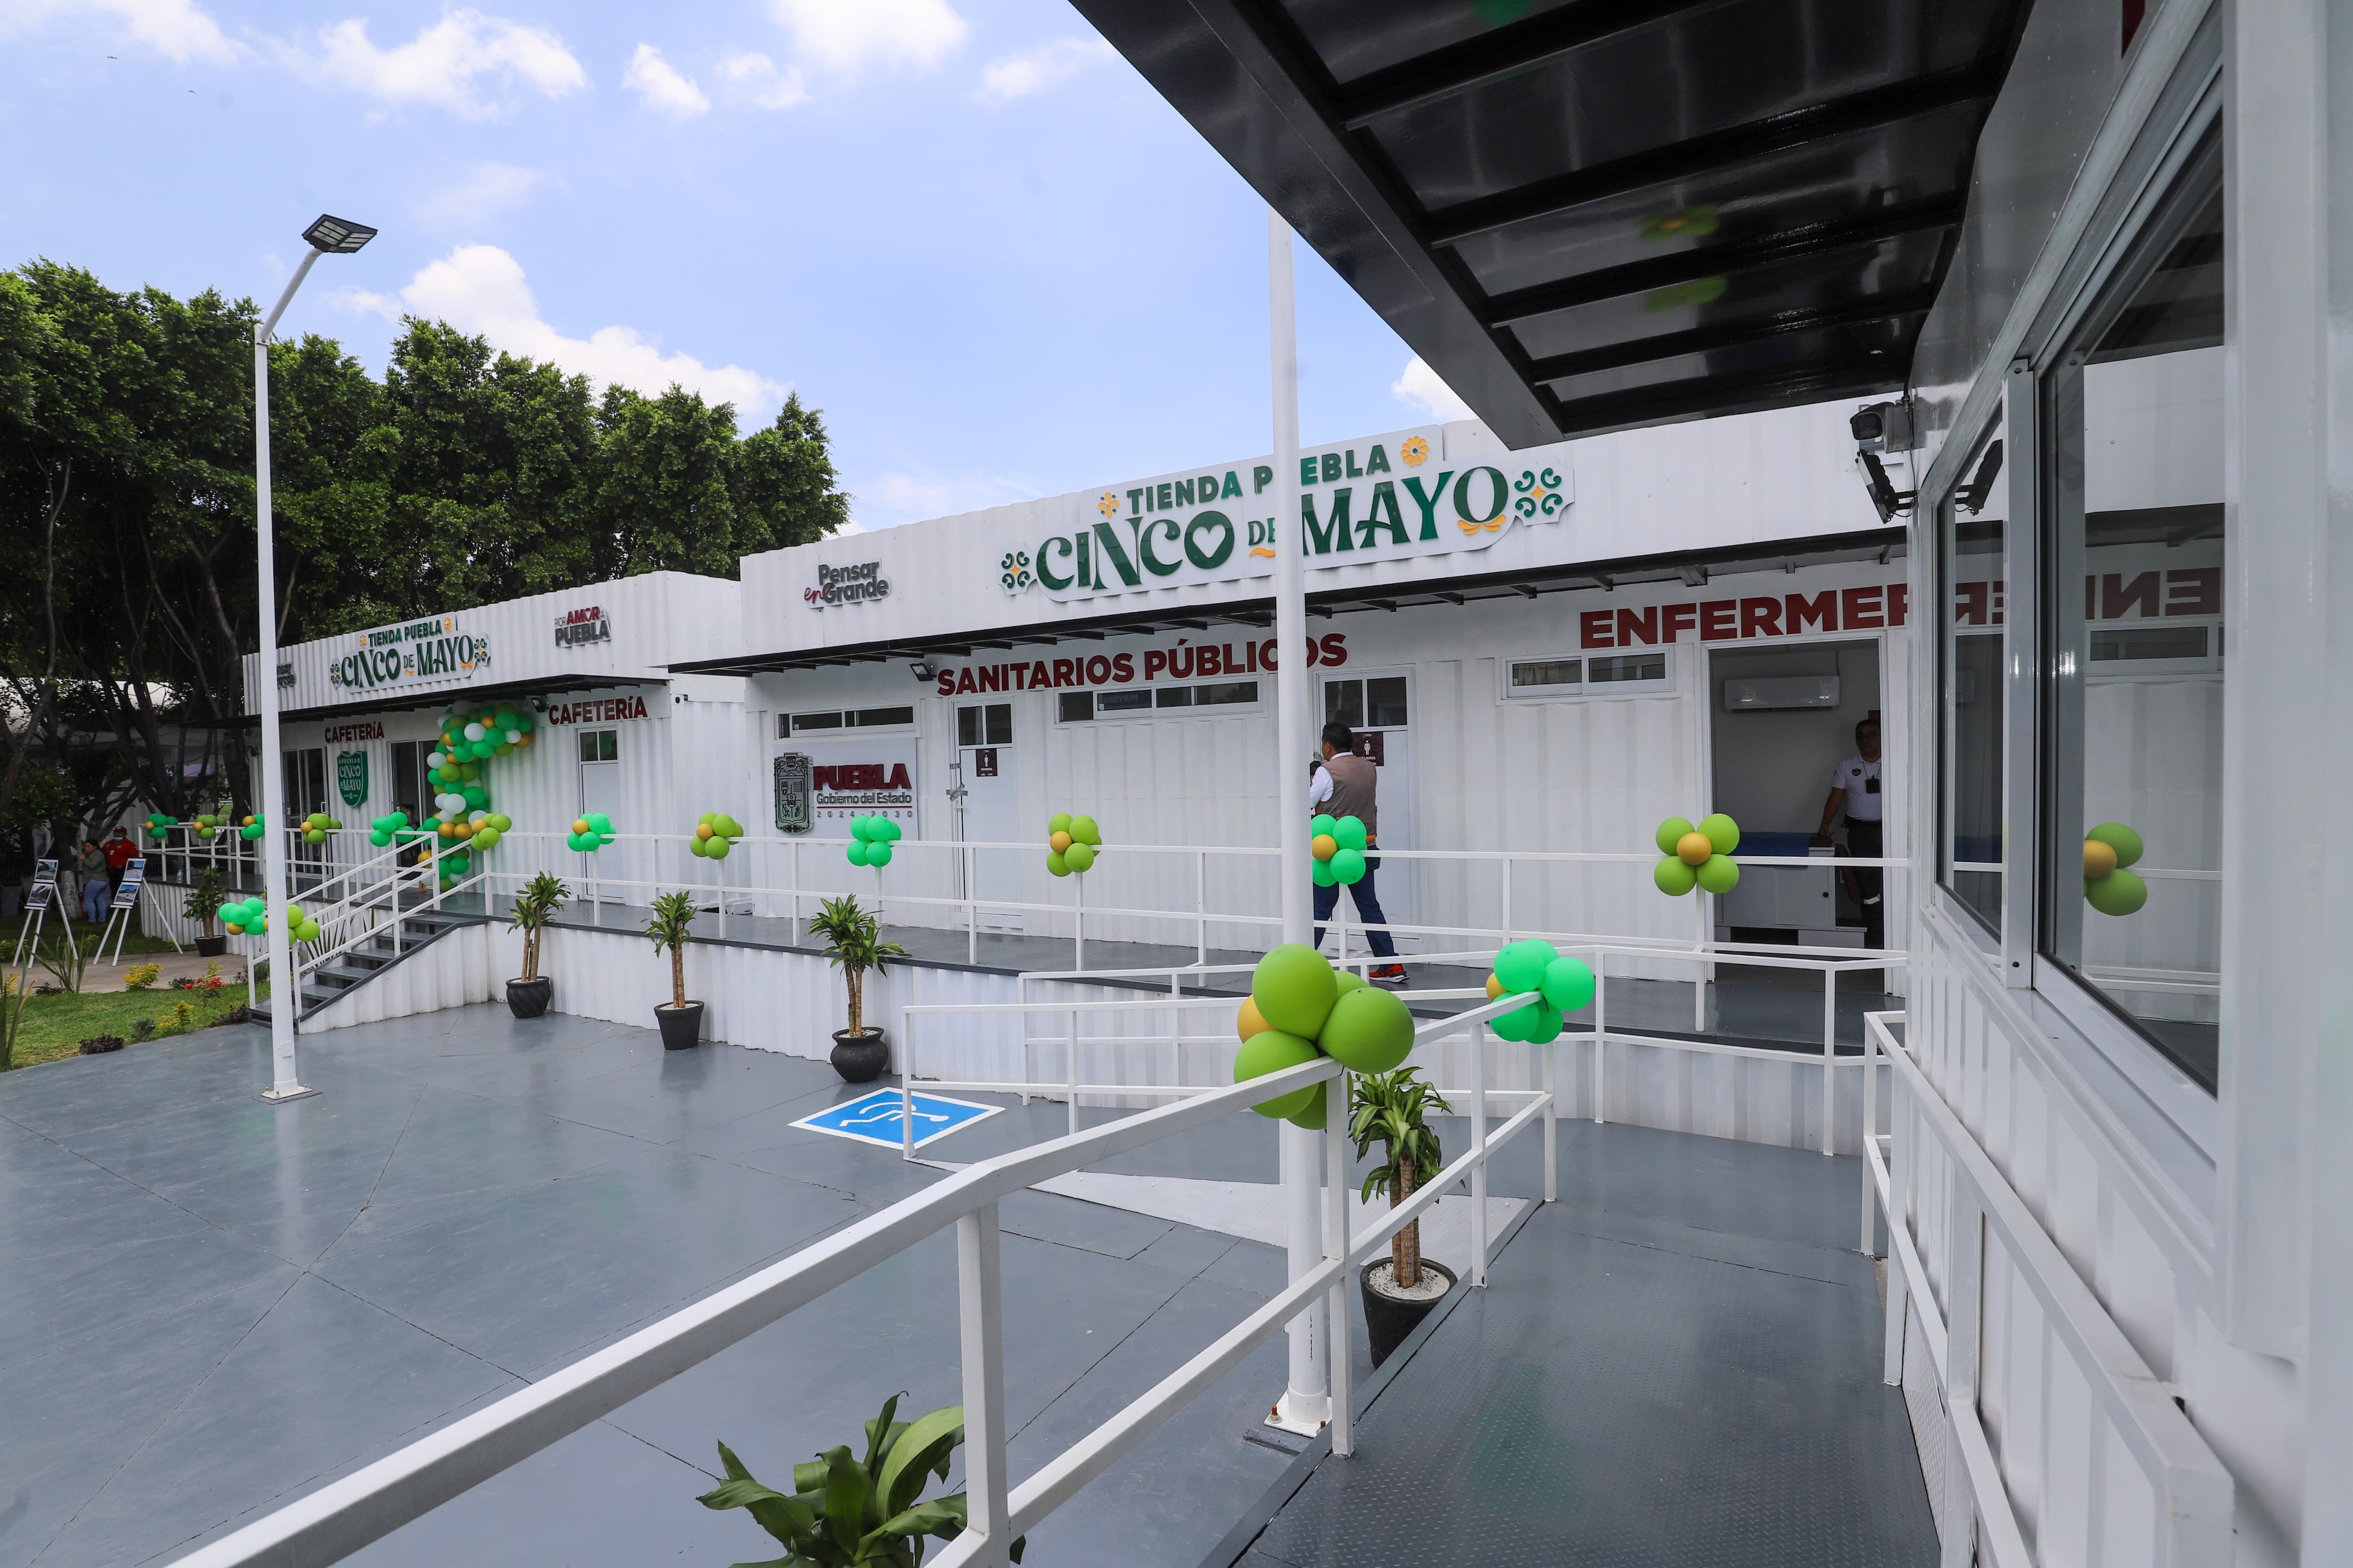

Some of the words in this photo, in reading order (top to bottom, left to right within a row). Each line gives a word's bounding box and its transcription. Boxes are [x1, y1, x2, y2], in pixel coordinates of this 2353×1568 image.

[1127, 471, 1243, 515] TIENDA
[1253, 444, 1391, 494] PEBLA
[1036, 510, 1235, 590] CINCO
[1302, 466, 1509, 556] MAYO
[818, 561, 880, 585] Pensar
[822, 576, 889, 603] Grande
[554, 617, 566, 627] POR
[567, 606, 600, 625] AMOR
[1580, 582, 1908, 649] ENFERME
[368, 627, 403, 648] TIENDA
[404, 620, 443, 641] PUEBLA
[555, 620, 611, 646] PUEBLA
[341, 648, 401, 688] CINCO
[403, 654, 415, 669] DE
[416, 634, 475, 676] MAYO
[937, 653, 1135, 696] SANITARIOS
[549, 696, 648, 725] CAFETERÍA
[325, 722, 385, 743] CAFETERÍA
[339, 764, 361, 778] CINCO
[813, 763, 912, 791] PUEBLA
[343, 779, 361, 791] MAYO
[817, 792, 859, 804] Gobierno
[860, 793, 875, 804] del
[877, 792, 912, 804] Estado
